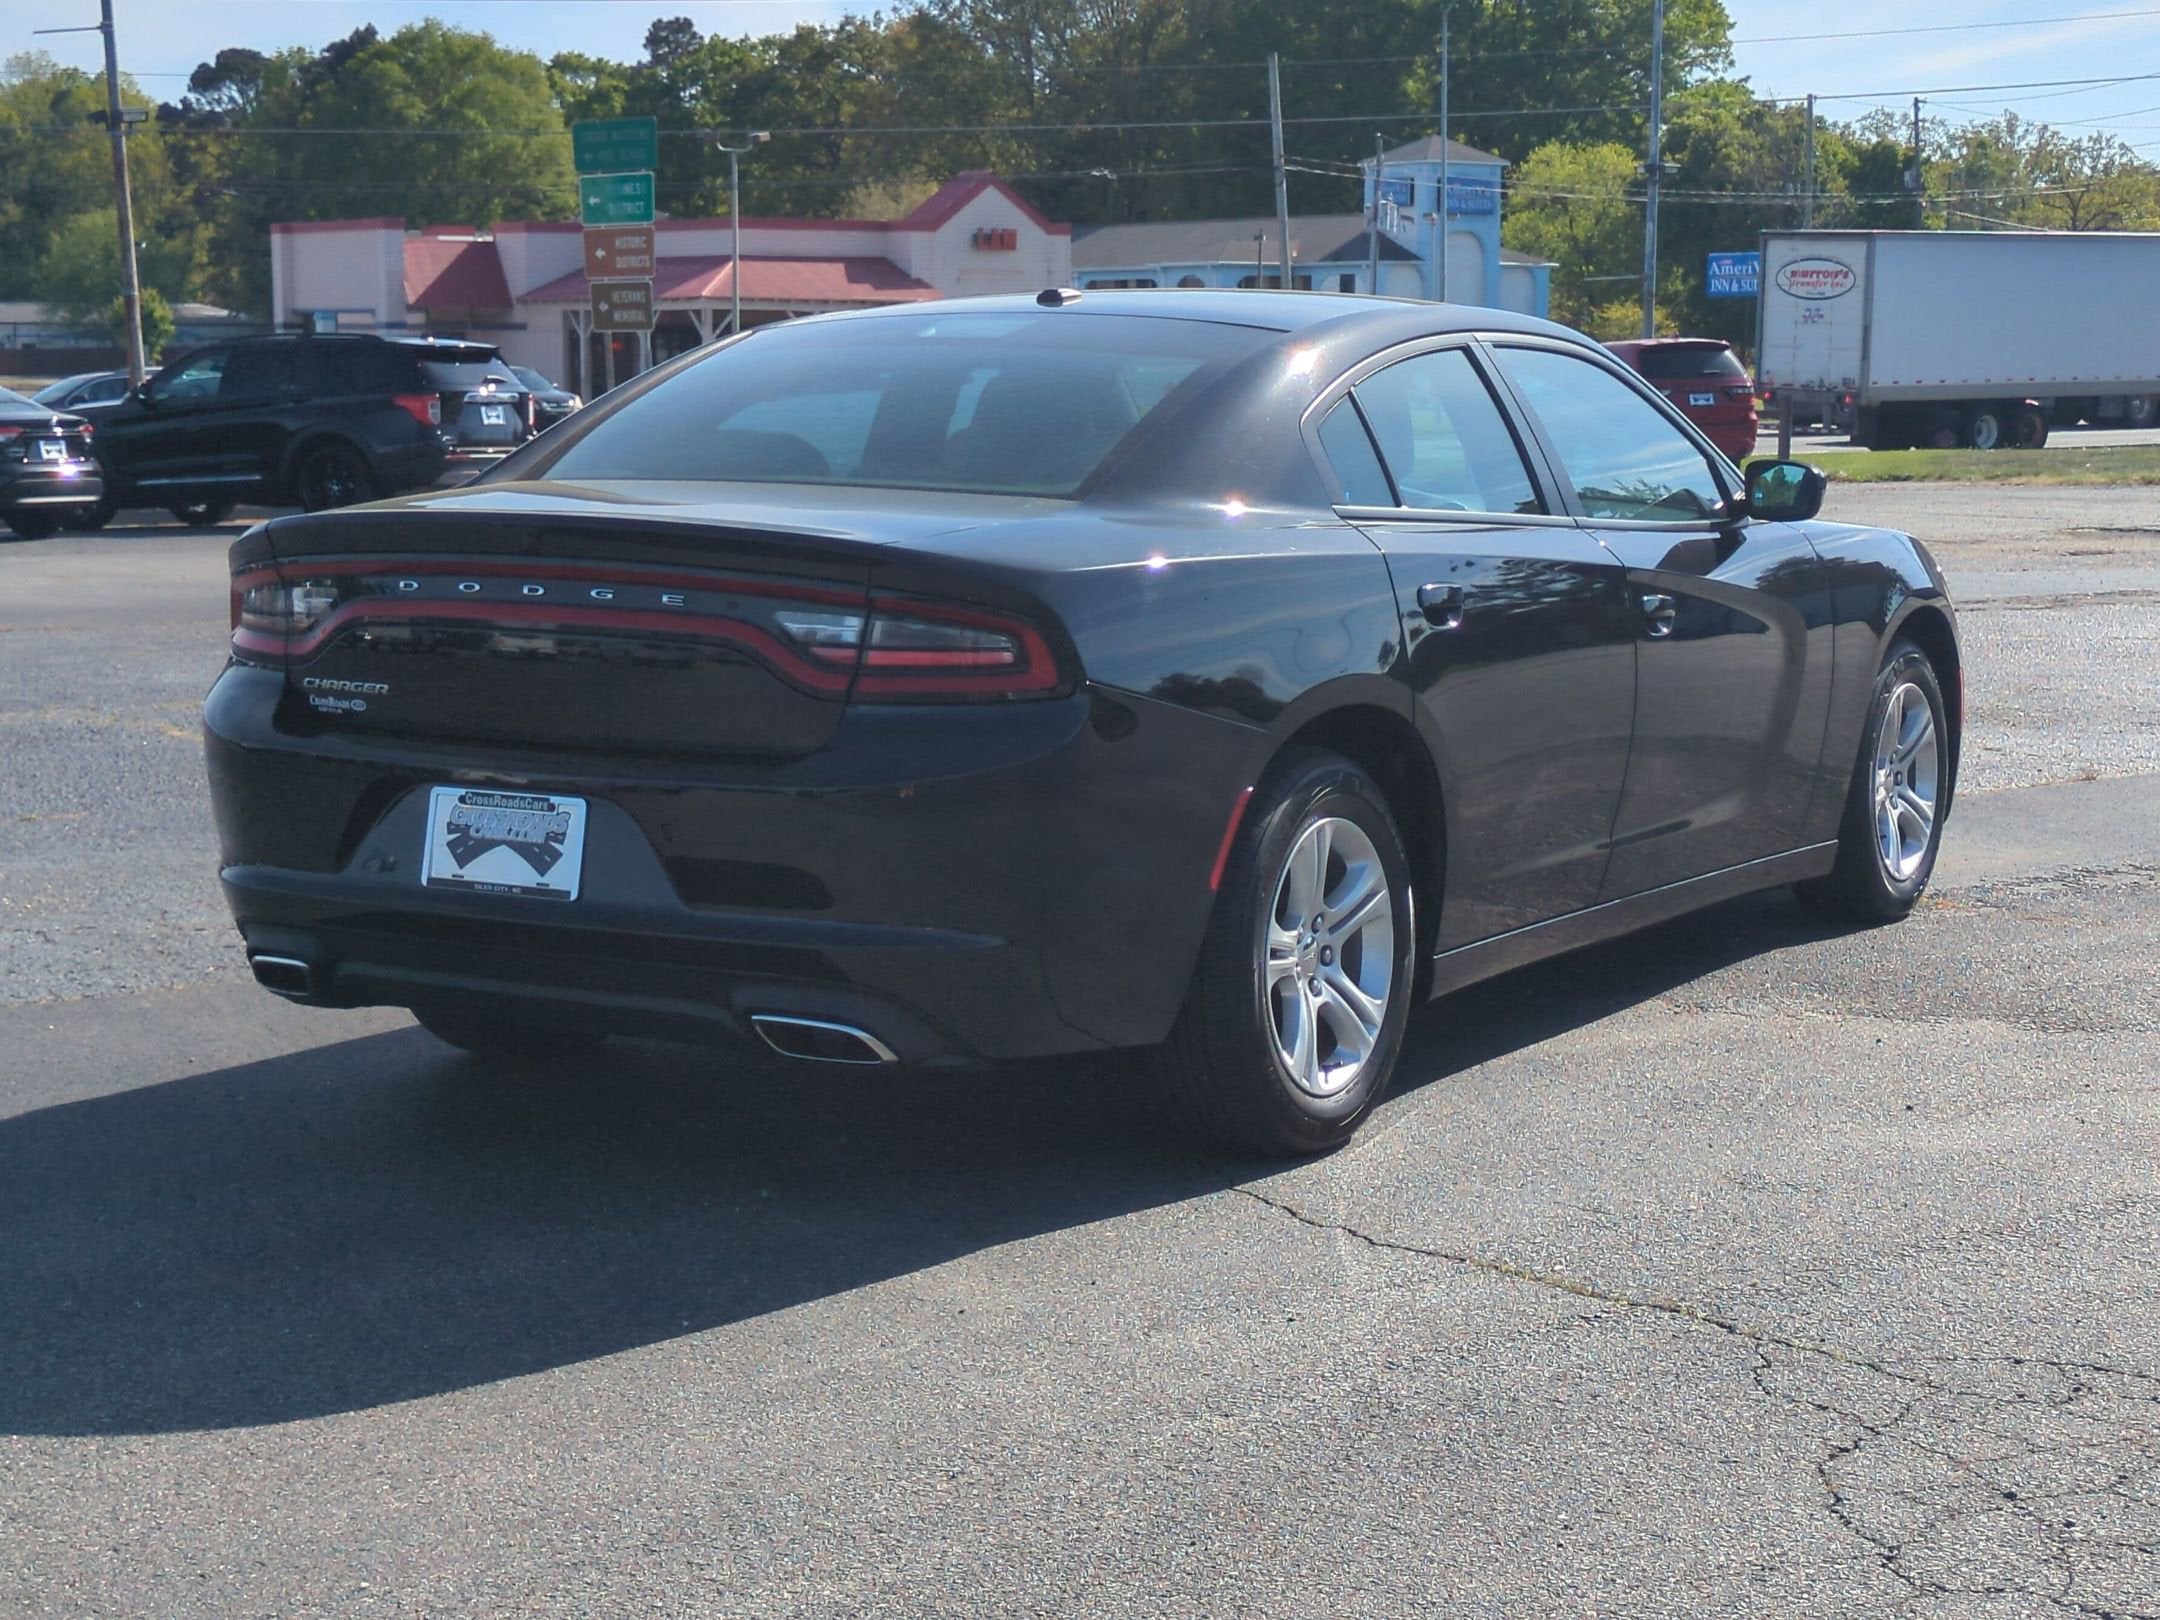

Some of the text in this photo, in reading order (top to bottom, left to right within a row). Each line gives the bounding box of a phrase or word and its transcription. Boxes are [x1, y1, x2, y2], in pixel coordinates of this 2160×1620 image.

[615, 235, 648, 249] HISTORIC
[615, 255, 650, 268] DISTRICTS
[1711, 279, 1730, 293] INN
[1731, 279, 1739, 292] &
[612, 290, 647, 304] VETERANS
[613, 309, 647, 323] MEMORIAL
[399, 580, 684, 606] DODGE
[303, 677, 389, 695] CHARGER
[465, 793, 548, 811] CrossRoadsCars
